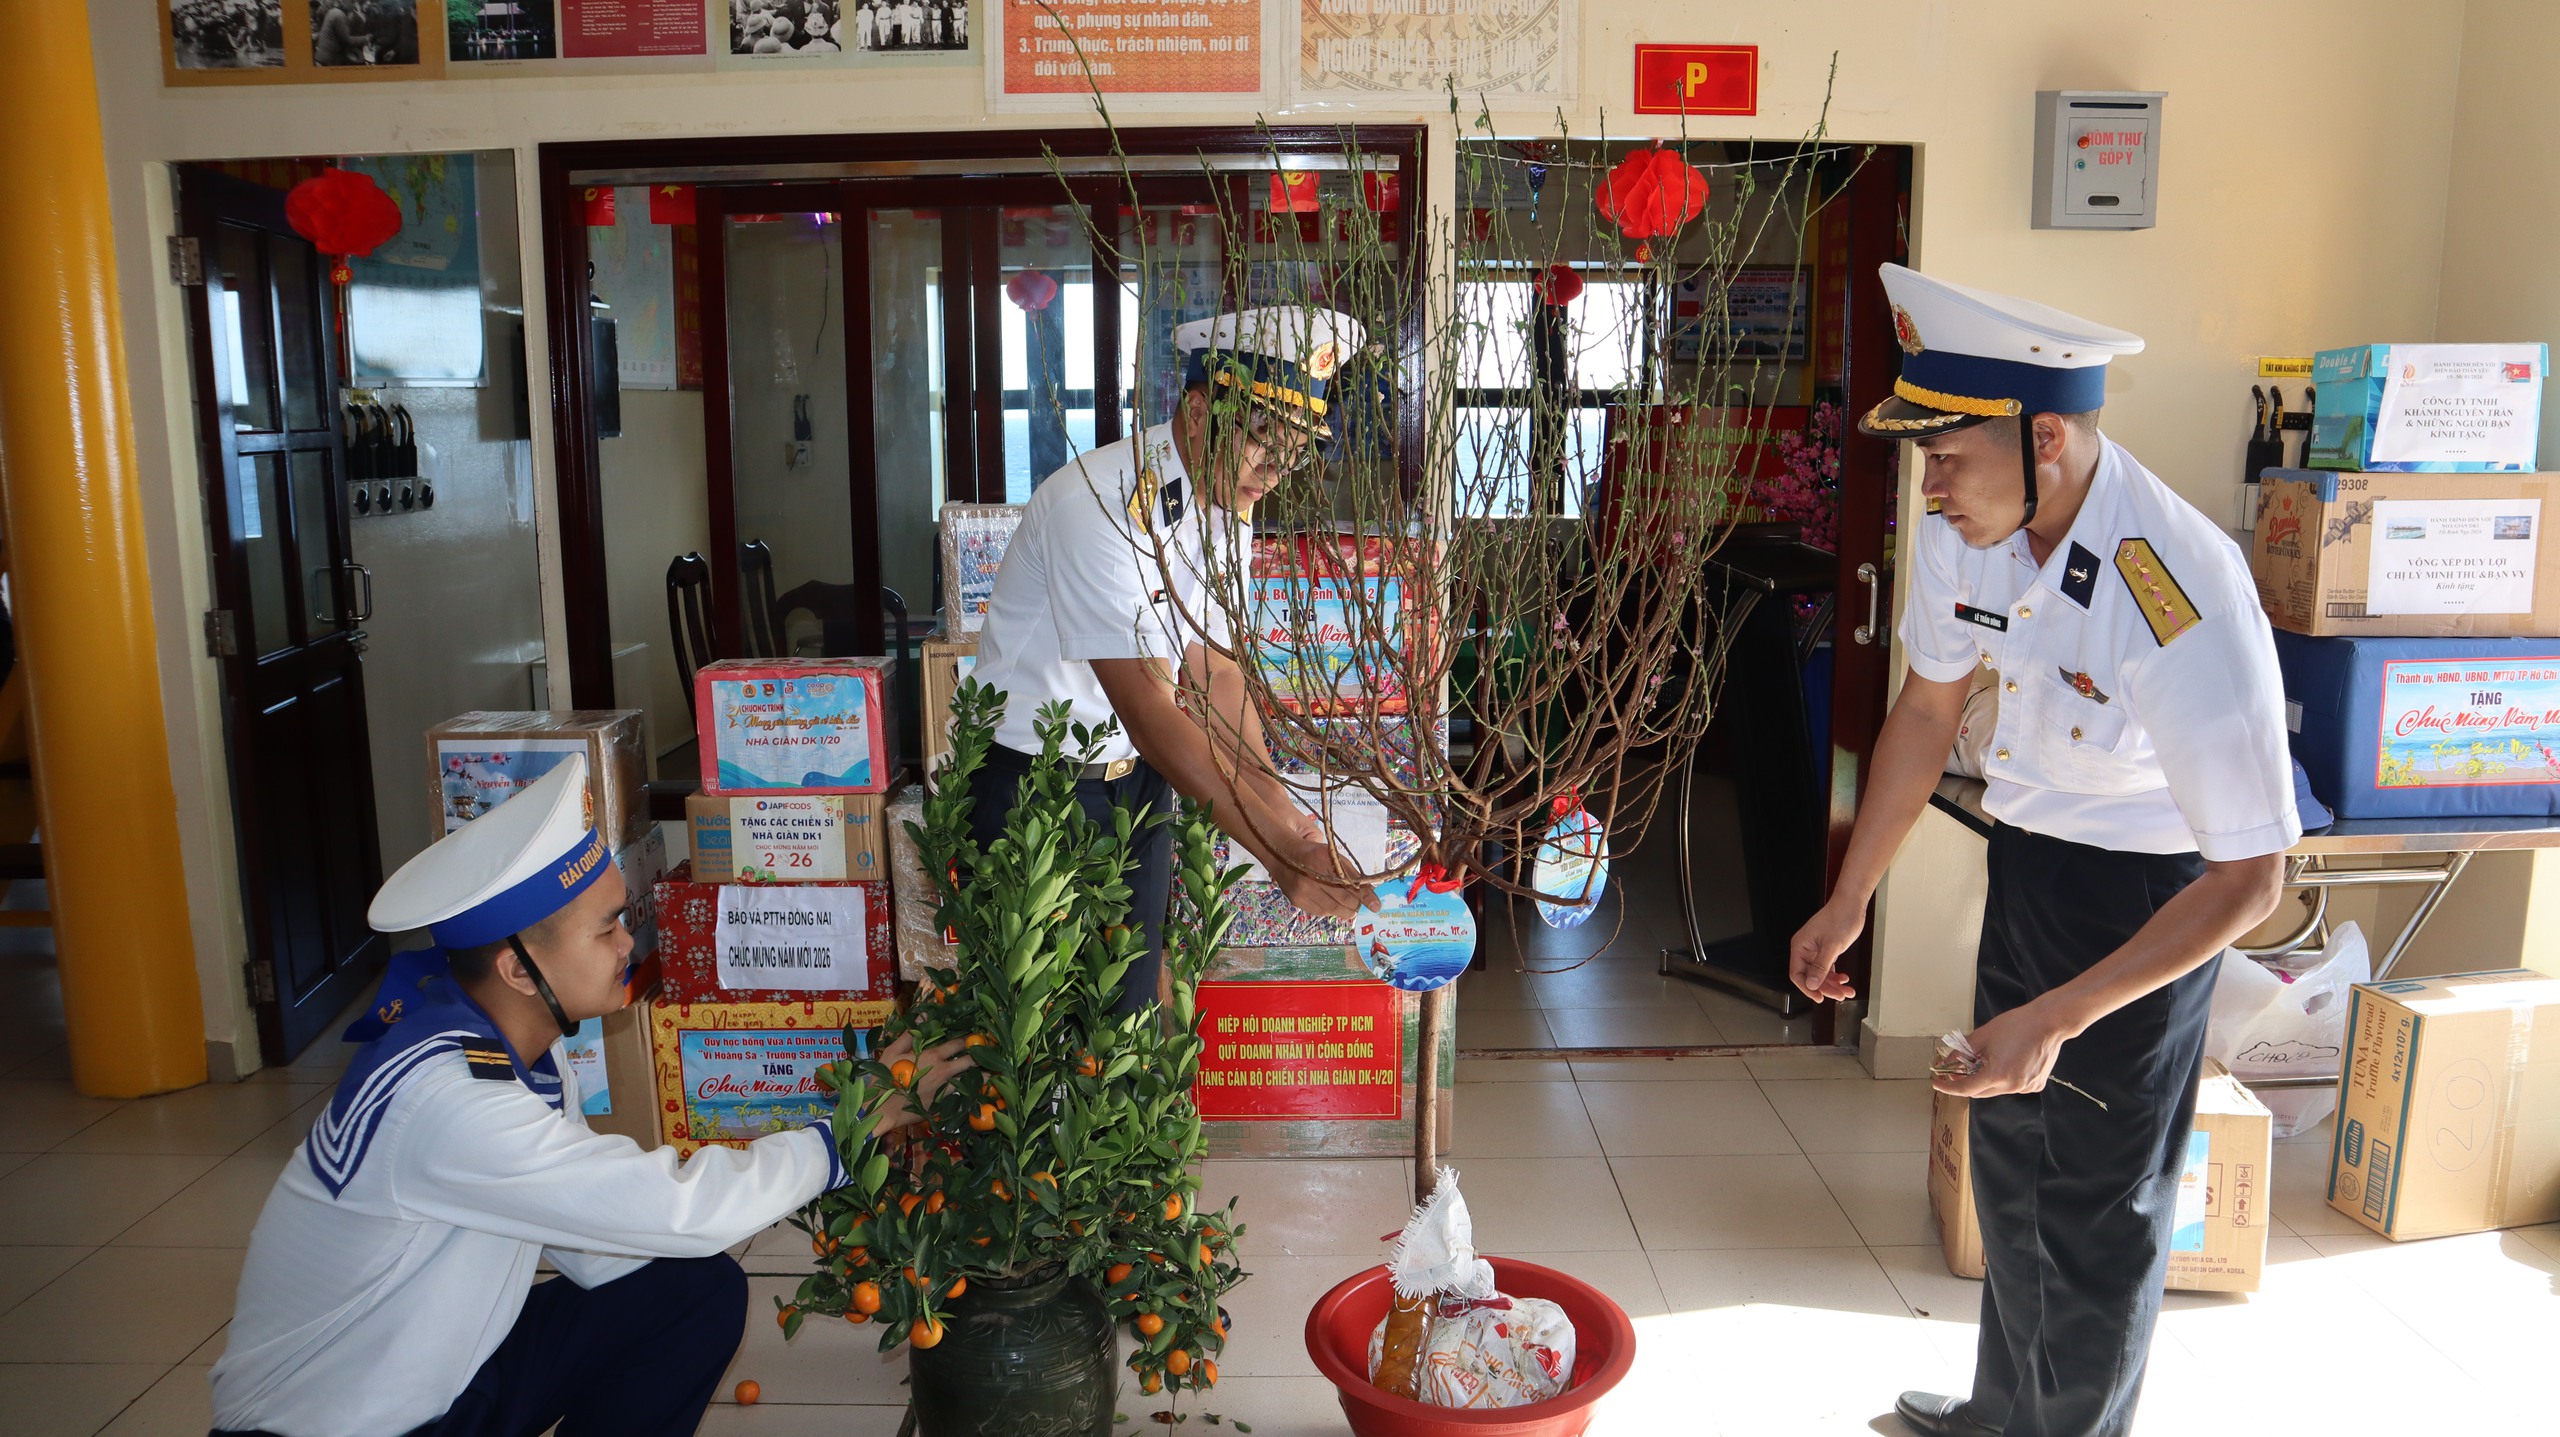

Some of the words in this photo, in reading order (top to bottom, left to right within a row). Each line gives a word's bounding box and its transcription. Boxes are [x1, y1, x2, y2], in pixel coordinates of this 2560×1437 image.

[1077, 12, 1121, 30] phụng
[1124, 12, 1142, 32] sự
[1144, 12, 1180, 27] nhân
[1182, 11, 1213, 27] dân.
[1019, 37, 1030, 53] 3.
[1034, 37, 1074, 54] Trung
[1116, 36, 1154, 52] trách
[1156, 36, 1207, 55] nhiệm,
[1209, 36, 1232, 52] nói
[1235, 36, 1249, 52] đi
[1034, 60, 1057, 76] đôi
[1059, 60, 1081, 76] với
[1686, 62, 1708, 98] P
[2117, 131, 2143, 146] THƯ
[2099, 147, 2124, 165] GÓP
[2126, 147, 2134, 165] Ý
[2320, 355, 2348, 369] Double
[2349, 352, 2357, 366] A
[2422, 396, 2452, 406] CÔNG
[2455, 398, 2469, 406] TY
[2471, 398, 2498, 406] TNHH
[2403, 406, 2441, 417] KHÁNH
[2405, 420, 2414, 428] &
[2491, 420, 2511, 430] BẠN
[2430, 430, 2456, 438] KÍNH
[2464, 557, 2485, 567] DUY
[2488, 557, 2507, 568] LỢI
[2386, 571, 2406, 582] CHỊ
[2408, 570, 2422, 580] LÝ
[2425, 570, 2454, 580] MINH
[2511, 569, 2526, 579] VY
[2436, 582, 2455, 591] Kính
[2395, 672, 2421, 684] Thành
[2465, 671, 2490, 683] UBND,
[2493, 671, 2515, 682] MTTQ
[2518, 670, 2528, 681] TP
[2530, 669, 2541, 680] Hồ
[2543, 669, 2557, 680] Chí
[2470, 690, 2502, 708] TẶNG
[745, 735, 769, 747] NHÀ
[772, 735, 799, 747] GIÀN
[801, 737, 816, 746] DK
[819, 735, 841, 746] 1/20
[741, 816, 766, 829] TẶNG
[769, 817, 788, 827] CÁC
[791, 815, 821, 827] CHIẾN
[824, 817, 834, 827] SĨ
[752, 829, 773, 840] NHÀ
[776, 829, 799, 840] GIÀN
[755, 843, 772, 851] CHÚC
[558, 860, 583, 889] HẢI
[580, 844, 604, 873] QUÂN
[728, 906, 748, 925] BÁO
[749, 907, 762, 925] VÀ
[763, 911, 786, 926] PTTH
[816, 911, 832, 925] NAI
[728, 940, 751, 968] CHÚC
[752, 940, 776, 968] MỪNG
[778, 941, 795, 968] NĂM
[797, 940, 812, 968] MỚI
[813, 947, 831, 969] 2026
[1217, 1014, 1240, 1036] HIỆP
[1242, 1015, 1259, 1036] HỘI
[1262, 1016, 1295, 1033] DOANH
[1298, 1013, 1333, 1035] NGHIỆP
[1336, 1016, 1348, 1032] TP
[1351, 1016, 1373, 1032] HCM
[2372, 1007, 2387, 1057] Flavour
[723, 1037, 740, 1049] học
[786, 1037, 792, 1045] A
[818, 1036, 829, 1046] và
[1218, 1041, 1237, 1061] QUỸ
[1240, 1044, 1272, 1060] DOANH
[1275, 1041, 1303, 1059] NHÂN
[1305, 1041, 1315, 1059] VÌ
[1317, 1041, 1344, 1062] CỘNG
[1346, 1038, 1374, 1058] ĐỒNG
[2353, 1046, 2369, 1090] TUNA
[2364, 1002, 2375, 1042] spread
[714, 1051, 743, 1061] Hoàng
[745, 1051, 757, 1060] Sa
[765, 1050, 797, 1061] Trường
[799, 1050, 811, 1059] Sa
[762, 1062, 793, 1078] TẶNG
[1199, 1068, 1224, 1089] TẶNG
[1227, 1068, 1247, 1086] CÁN
[1250, 1068, 1263, 1089] BỘ
[1265, 1066, 1295, 1086] CHIẾN
[1297, 1067, 1308, 1086] SĨ
[1309, 1067, 1330, 1085] NHÀ
[1333, 1067, 1356, 1085] GIÀN
[1358, 1069, 1394, 1085] DK-I/20
[2365, 1057, 2380, 1101] Truffle
[2346, 1121, 2362, 1166] nautilus
